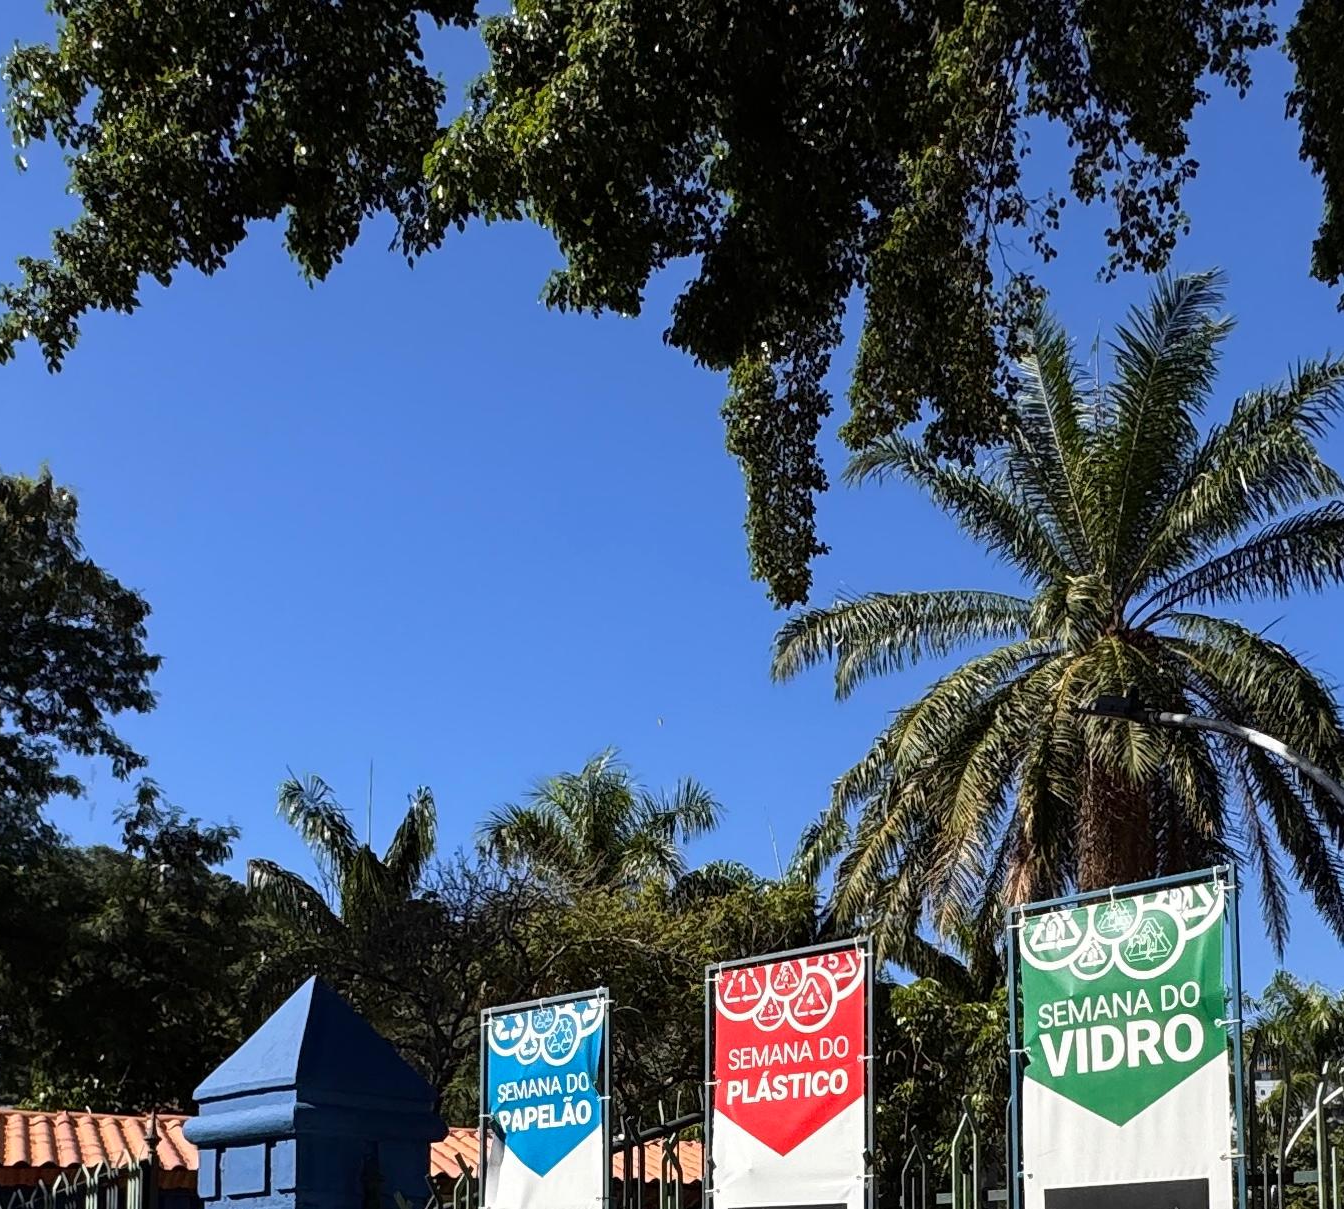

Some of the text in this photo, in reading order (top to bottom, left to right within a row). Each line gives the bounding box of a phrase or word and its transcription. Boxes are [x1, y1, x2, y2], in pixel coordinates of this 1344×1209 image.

[1037, 981, 1201, 1029] SEMANA DO
[728, 1035, 849, 1071] SEMANA DO
[1039, 1013, 1204, 1078] VIDRO
[497, 1071, 590, 1103] SEMANA DO
[726, 1068, 849, 1105] PLÁSTICO
[498, 1096, 592, 1133] PAPELÃO
